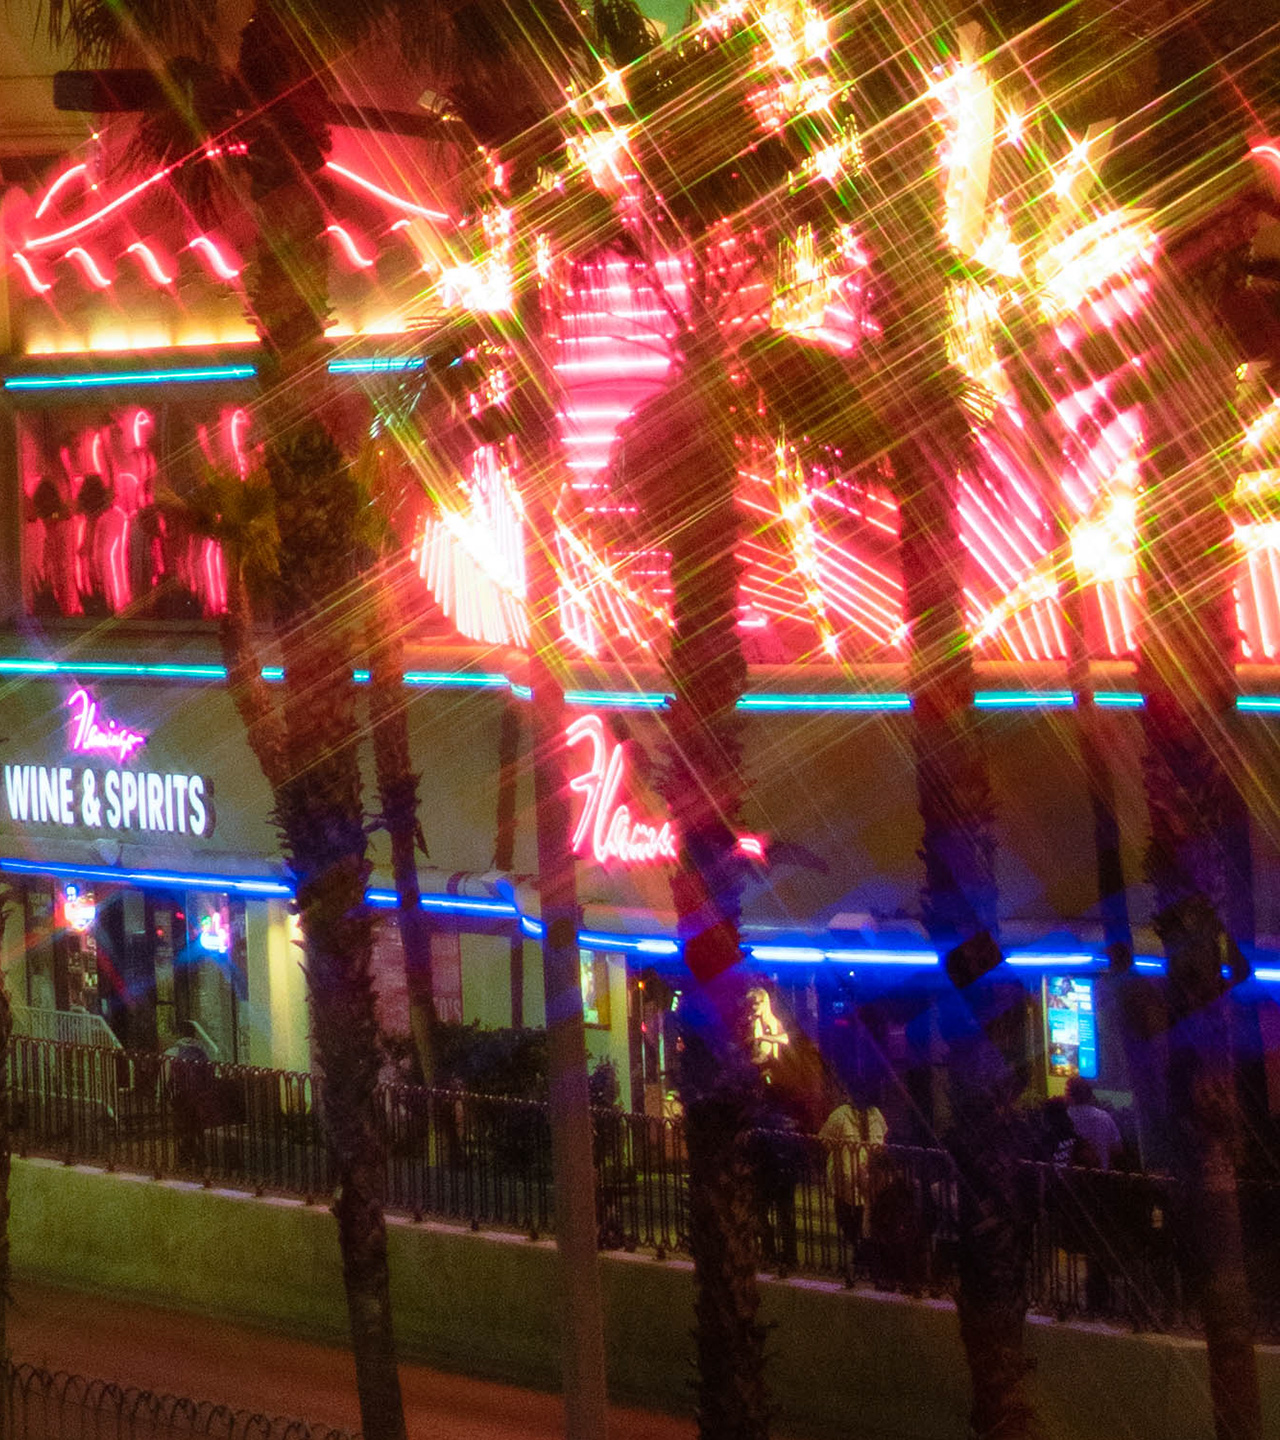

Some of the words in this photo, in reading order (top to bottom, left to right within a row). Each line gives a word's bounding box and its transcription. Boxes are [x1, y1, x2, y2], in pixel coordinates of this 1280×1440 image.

[67, 688, 145, 761] Flamingo
[3, 764, 76, 825] WINE
[80, 767, 103, 828] &
[103, 768, 208, 836] SPIRITS
